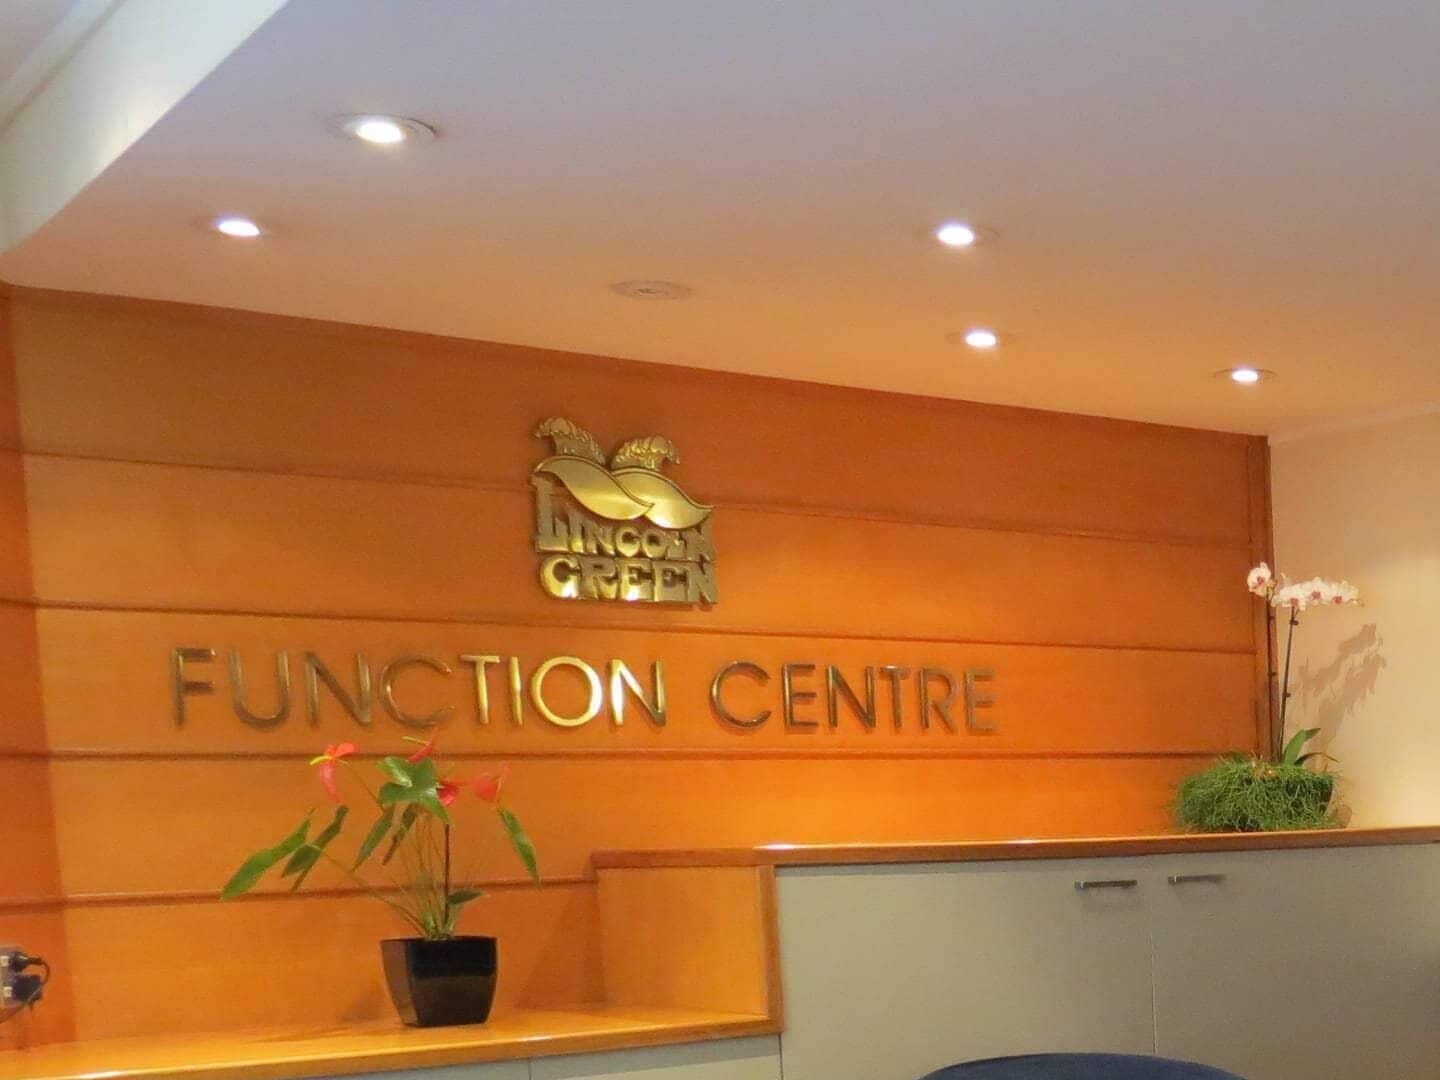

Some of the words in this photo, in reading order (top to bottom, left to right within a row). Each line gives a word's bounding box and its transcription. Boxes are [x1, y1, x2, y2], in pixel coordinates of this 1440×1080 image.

[540, 554, 716, 606] GREEN
[172, 647, 667, 728] FUNCTION
[709, 660, 998, 732] CENTRE
